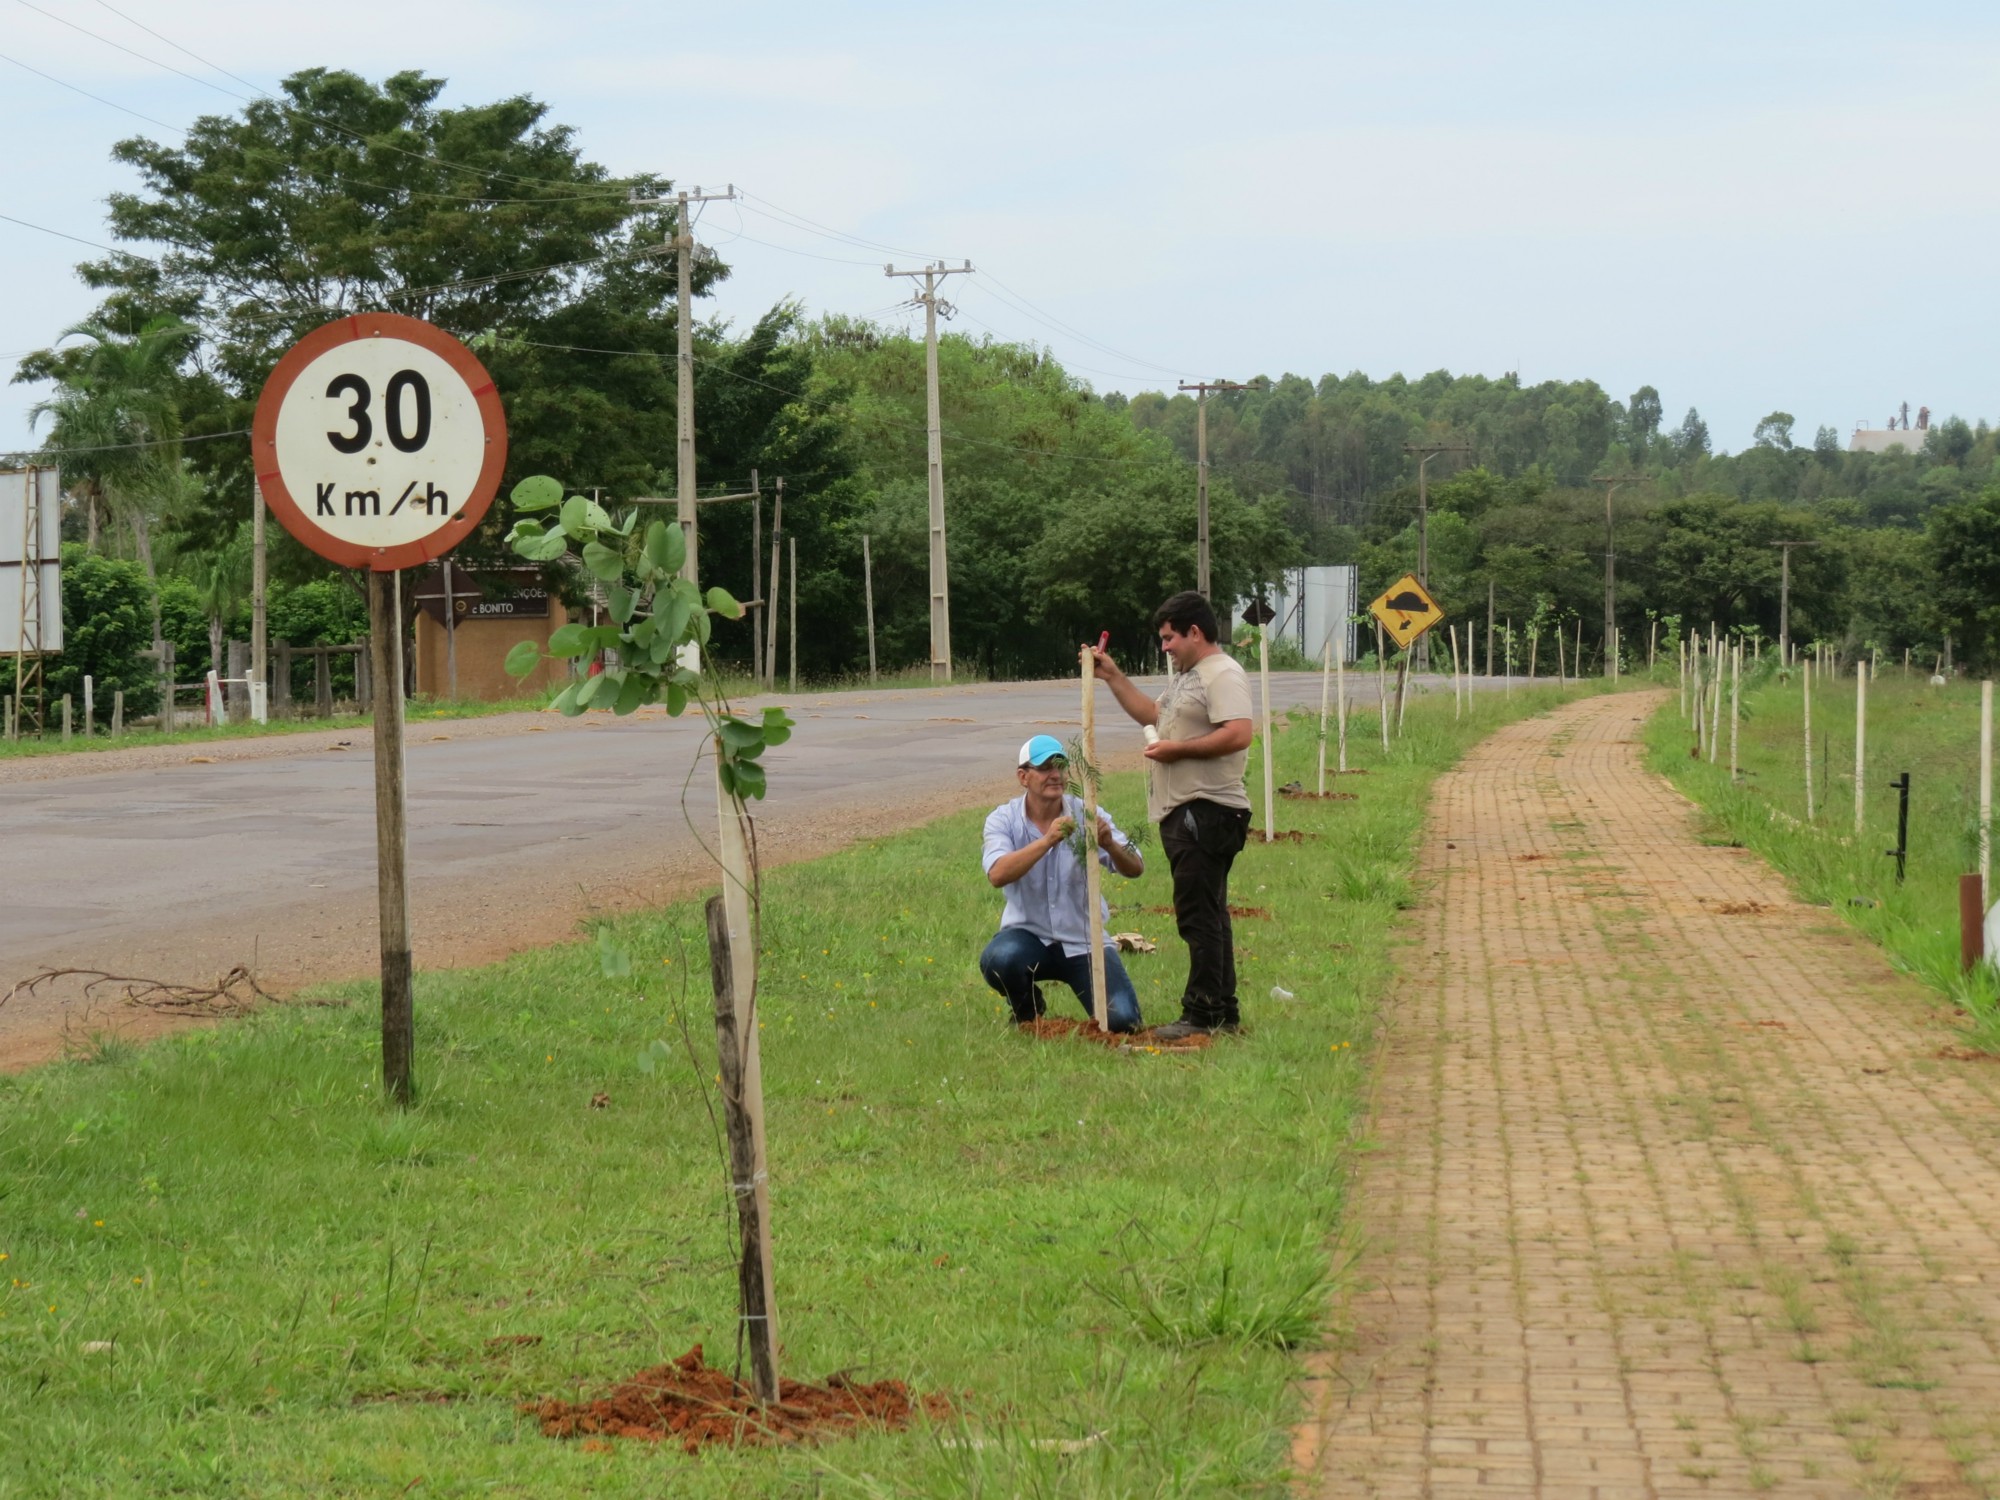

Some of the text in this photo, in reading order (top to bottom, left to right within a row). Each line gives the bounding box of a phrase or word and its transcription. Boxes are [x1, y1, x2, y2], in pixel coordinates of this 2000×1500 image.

[326, 369, 431, 454] 30
[317, 481, 448, 516] Km/h
[479, 603, 514, 614] BONITO
